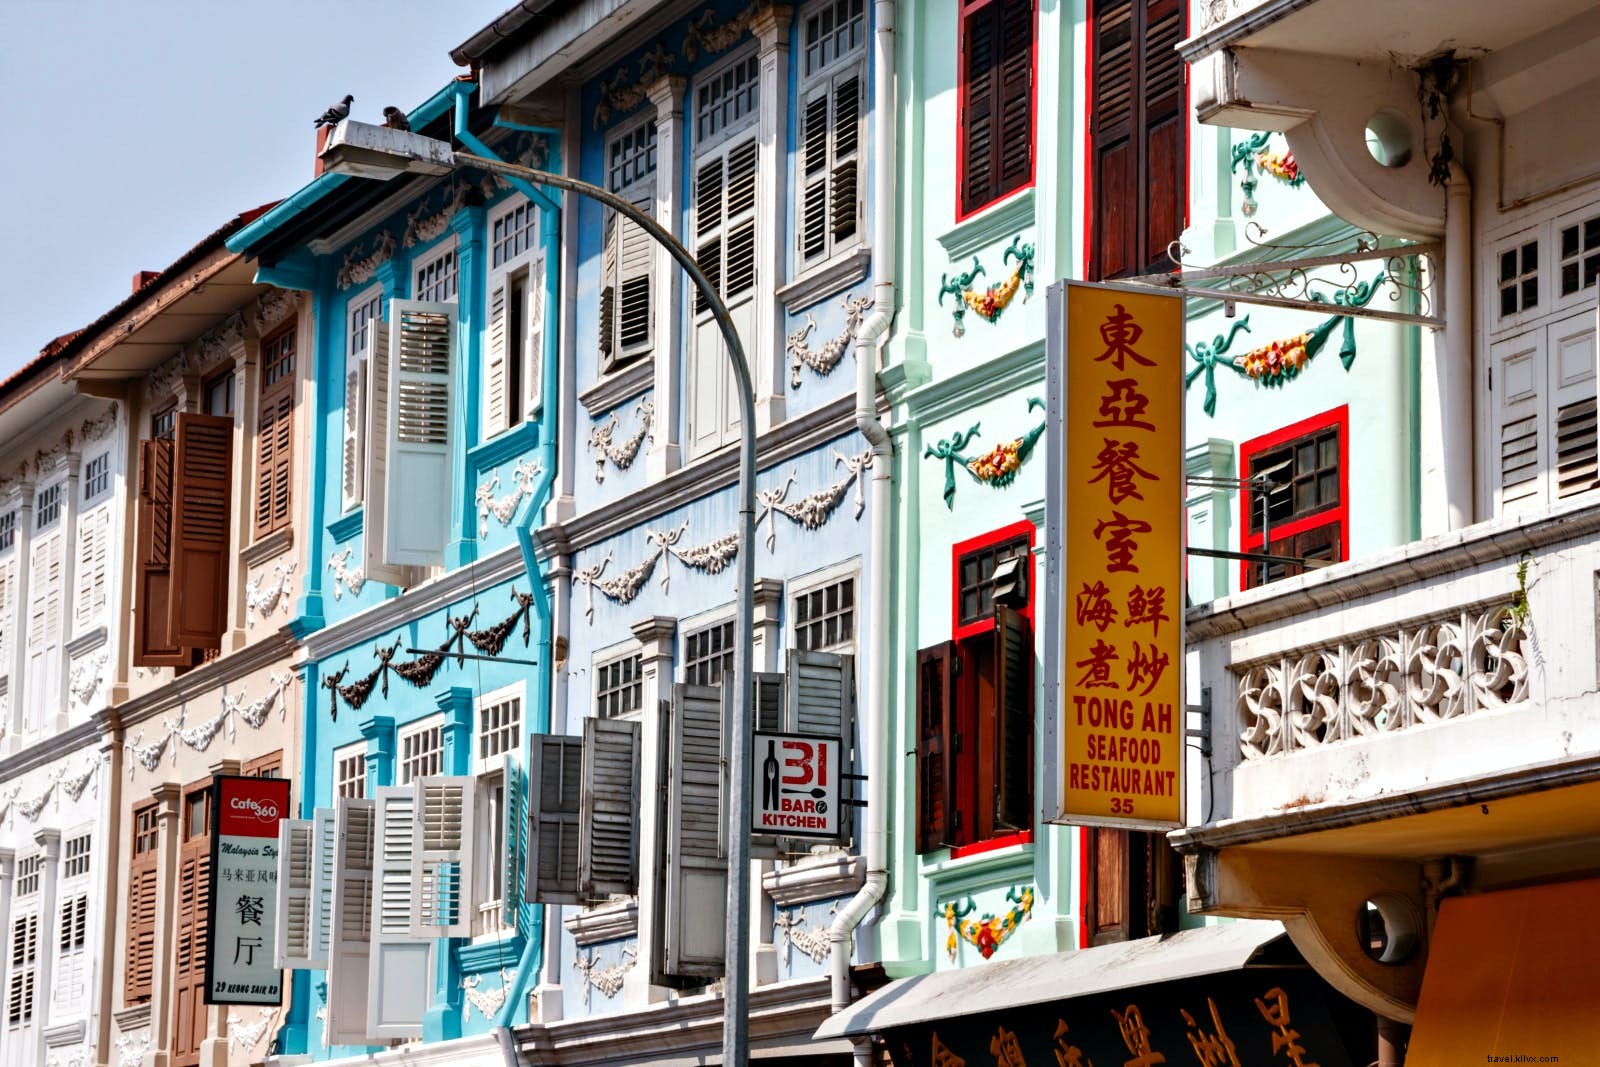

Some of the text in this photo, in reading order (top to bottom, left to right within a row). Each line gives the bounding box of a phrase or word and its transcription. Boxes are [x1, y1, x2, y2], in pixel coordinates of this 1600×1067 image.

[1088, 304, 1160, 573] 東亞餐室
[1076, 580, 1170, 638] 海鮮
[1075, 639, 1170, 696] 煮炒
[1073, 696, 1172, 733] TONG AH
[1087, 734, 1161, 764] SEAFOOD
[1070, 763, 1175, 796] RESTAURANT
[762, 814, 827, 828] KITCHEN
[781, 799, 815, 813] BAR
[1110, 797, 1134, 814] 35
[221, 843, 278, 859] Malaysia Sty
[233, 895, 264, 966] 餐厅
[215, 981, 278, 995] 29 KEONG SAIK RD
